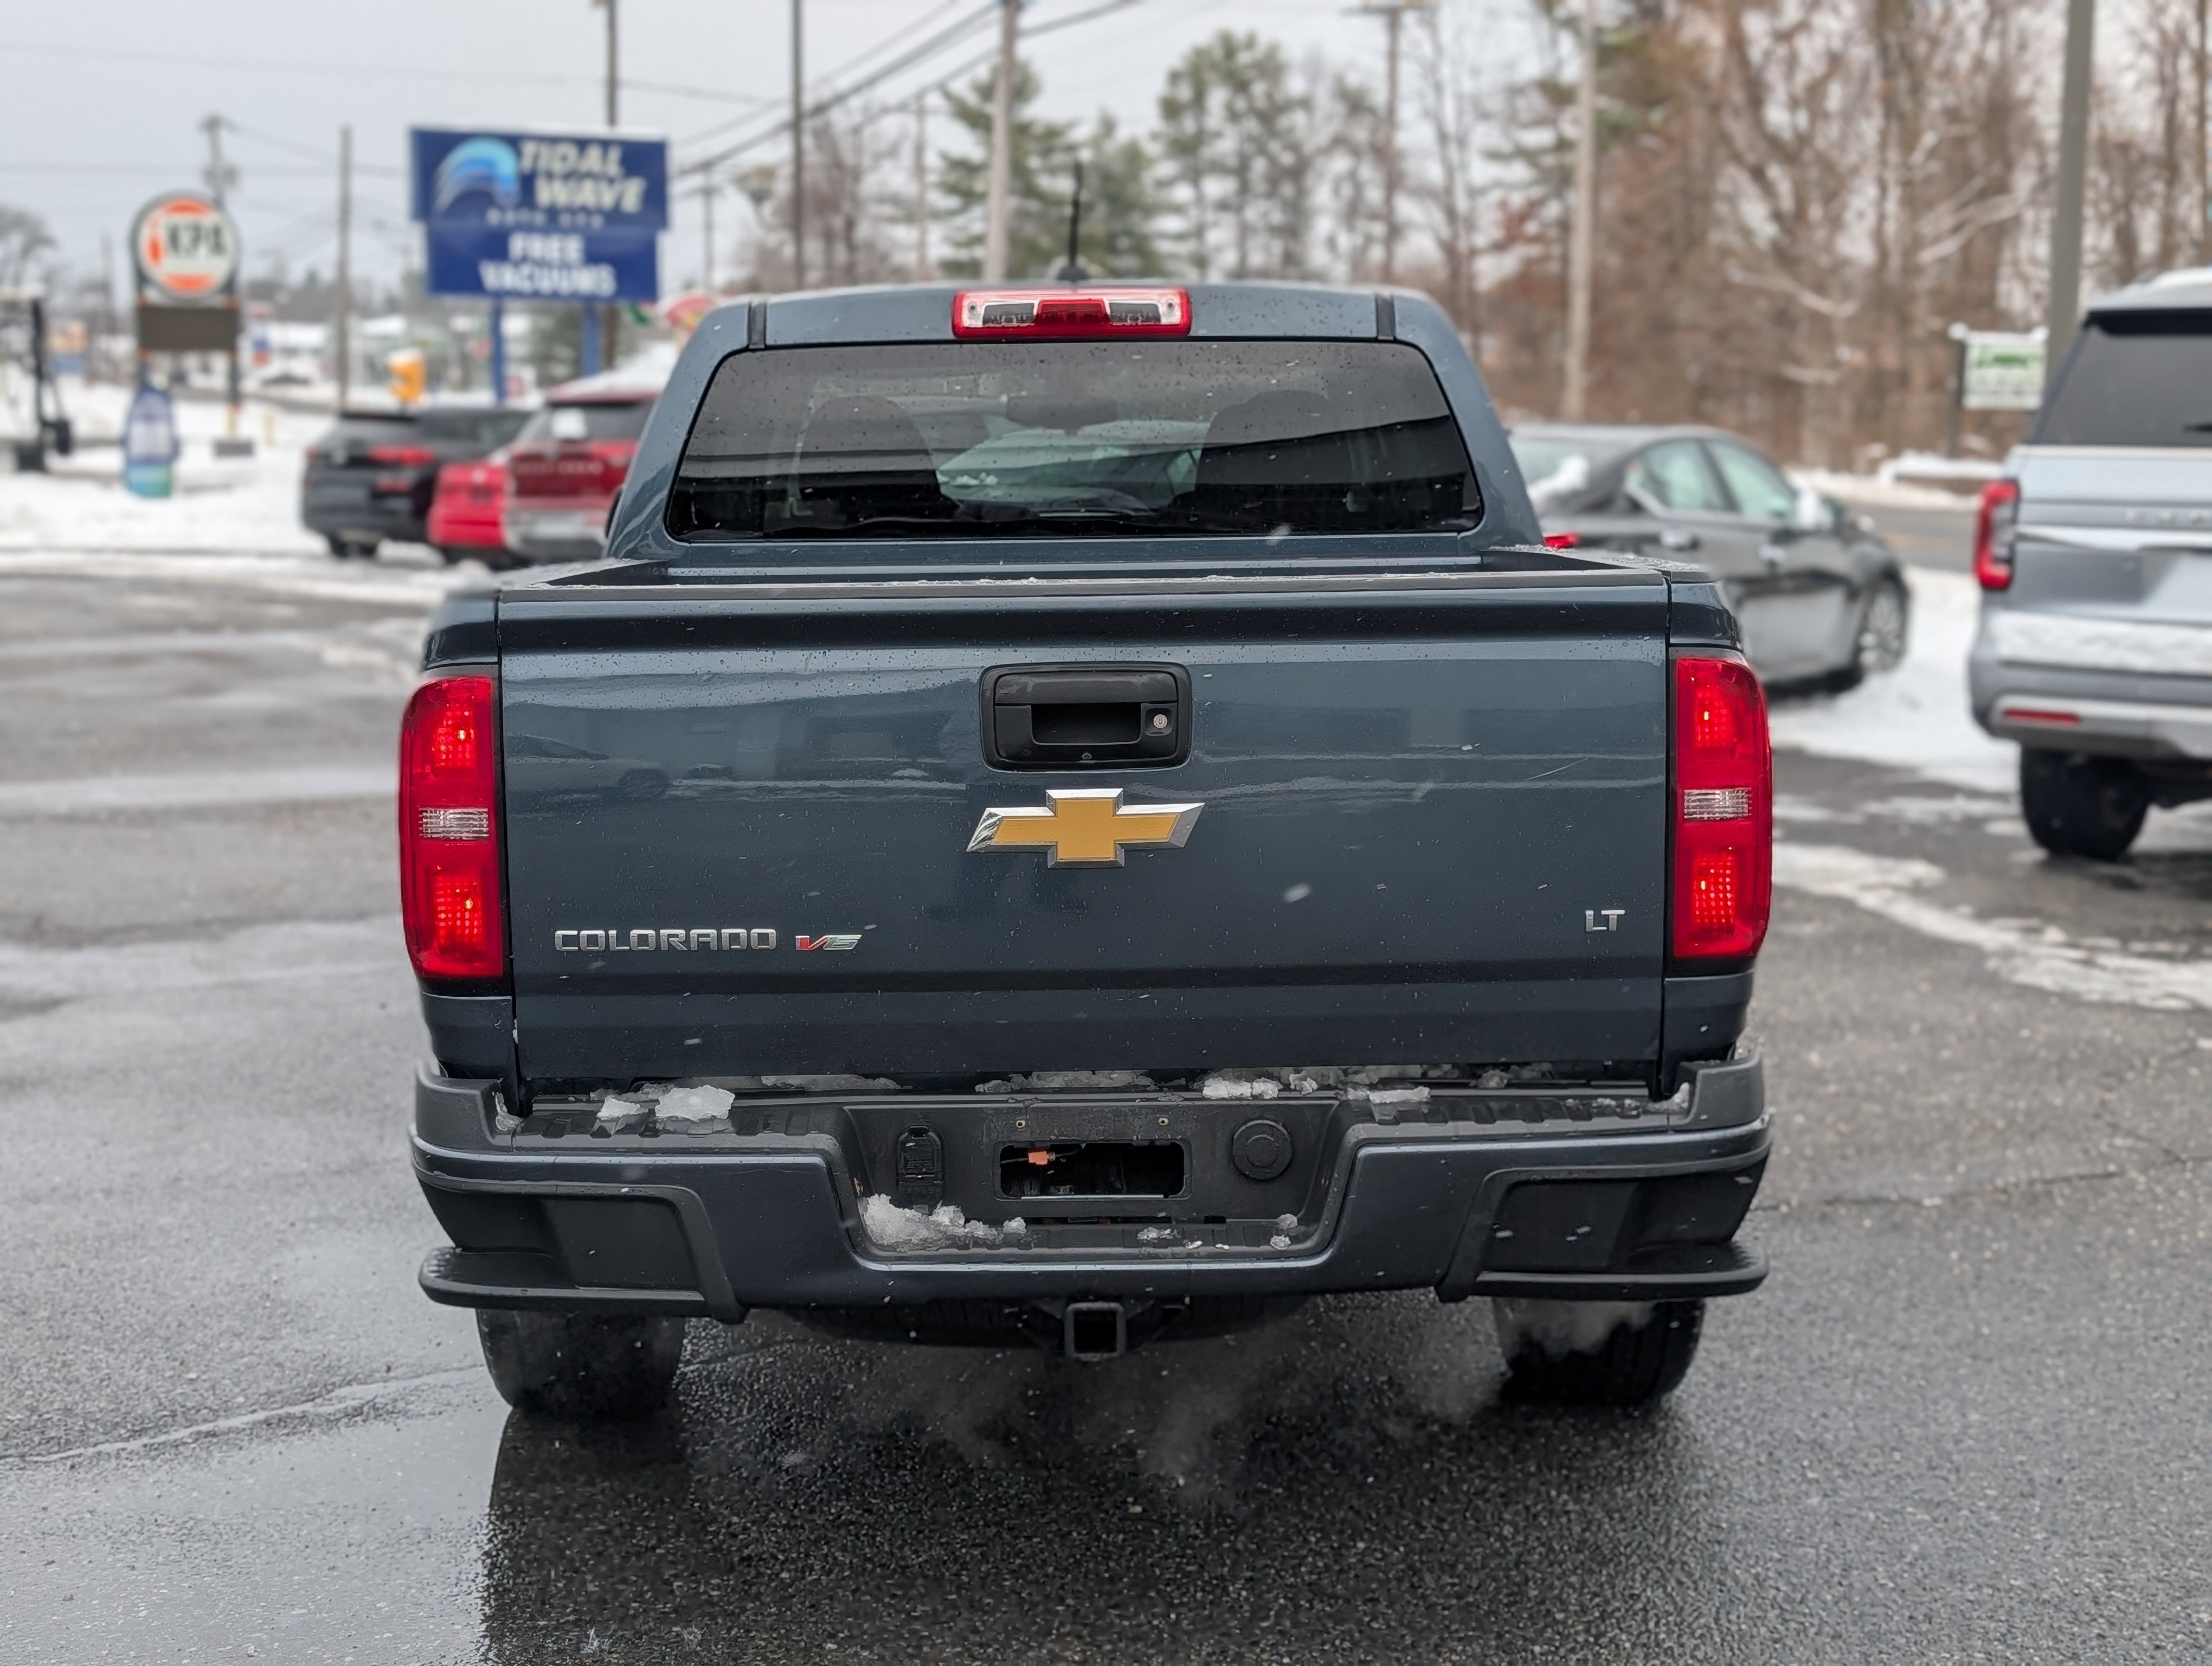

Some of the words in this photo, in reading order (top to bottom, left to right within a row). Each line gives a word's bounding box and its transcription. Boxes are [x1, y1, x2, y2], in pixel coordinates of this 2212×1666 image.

[519, 139, 625, 177] TIDAL
[535, 175, 646, 213] WAVE
[509, 232, 584, 264] FREE
[479, 260, 616, 297] VACUUMS
[1585, 909, 1625, 932] LT
[554, 928, 777, 952] COLORADO
[795, 934, 863, 951] V6
